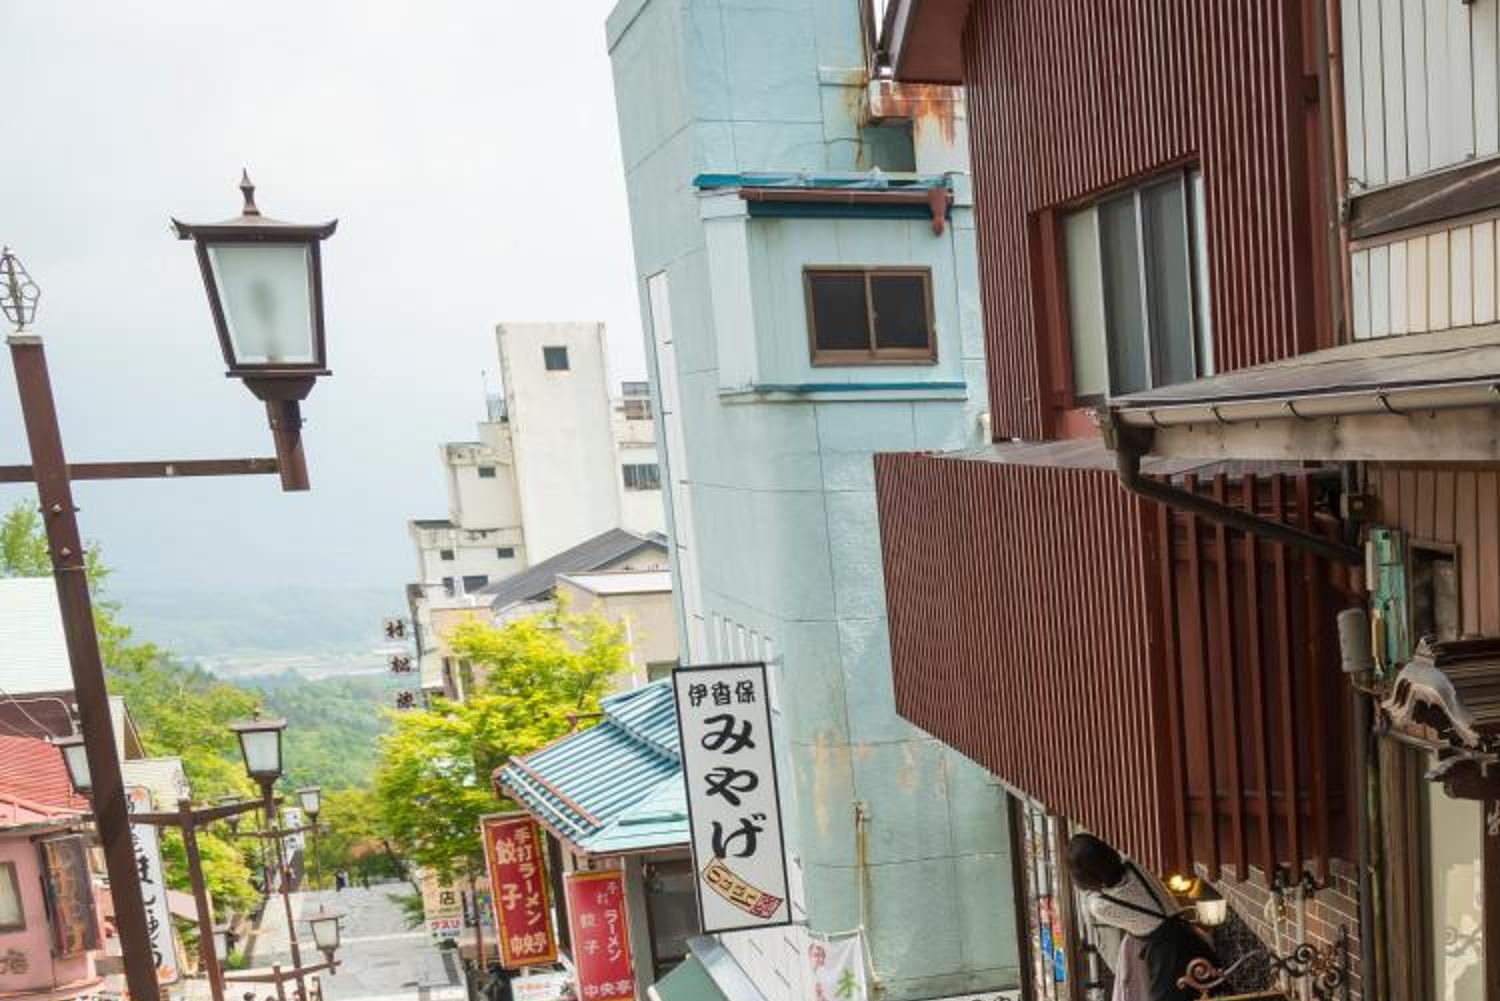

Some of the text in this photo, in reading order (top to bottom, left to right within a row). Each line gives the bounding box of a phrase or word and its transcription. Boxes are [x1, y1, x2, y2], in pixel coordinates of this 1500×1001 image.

[688, 679, 755, 707] 伊香保
[701, 713, 767, 859] みやげ
[495, 838, 523, 911] 餃子
